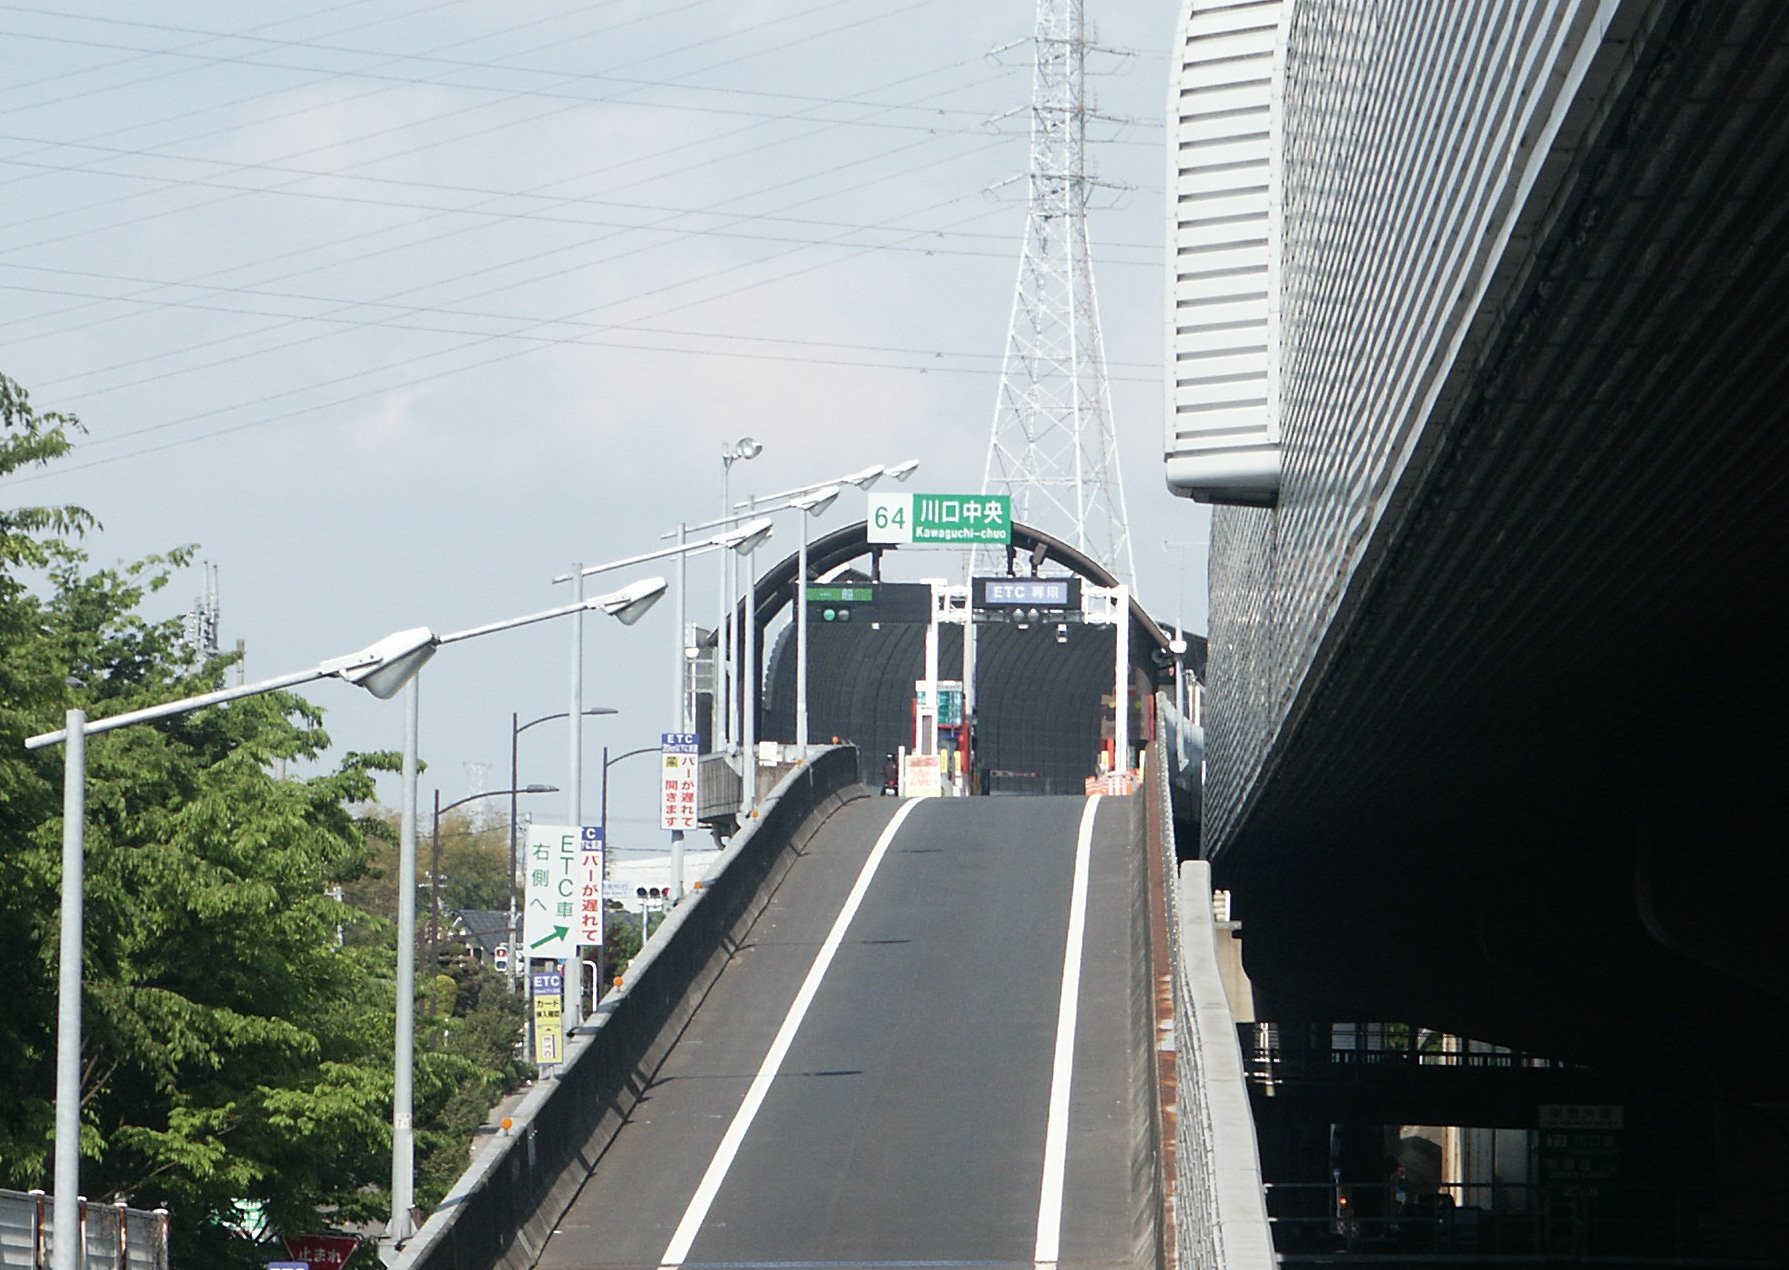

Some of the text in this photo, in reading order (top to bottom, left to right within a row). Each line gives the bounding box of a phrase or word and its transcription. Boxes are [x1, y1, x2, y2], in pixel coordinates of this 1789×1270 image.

[875, 506, 906, 529] 64
[919, 499, 1003, 524] 川口中央
[915, 526, 1007, 540] Kawaguchi-chuo
[993, 586, 1060, 599] ETC 専用
[667, 734, 693, 744] ETC
[665, 779, 678, 827] 開きます
[530, 842, 550, 911] 右側へ
[556, 835, 575, 918] ETC車
[533, 975, 560, 987] ETC
[536, 1000, 560, 1008] カード
[296, 1246, 341, 1263] 止まれ
